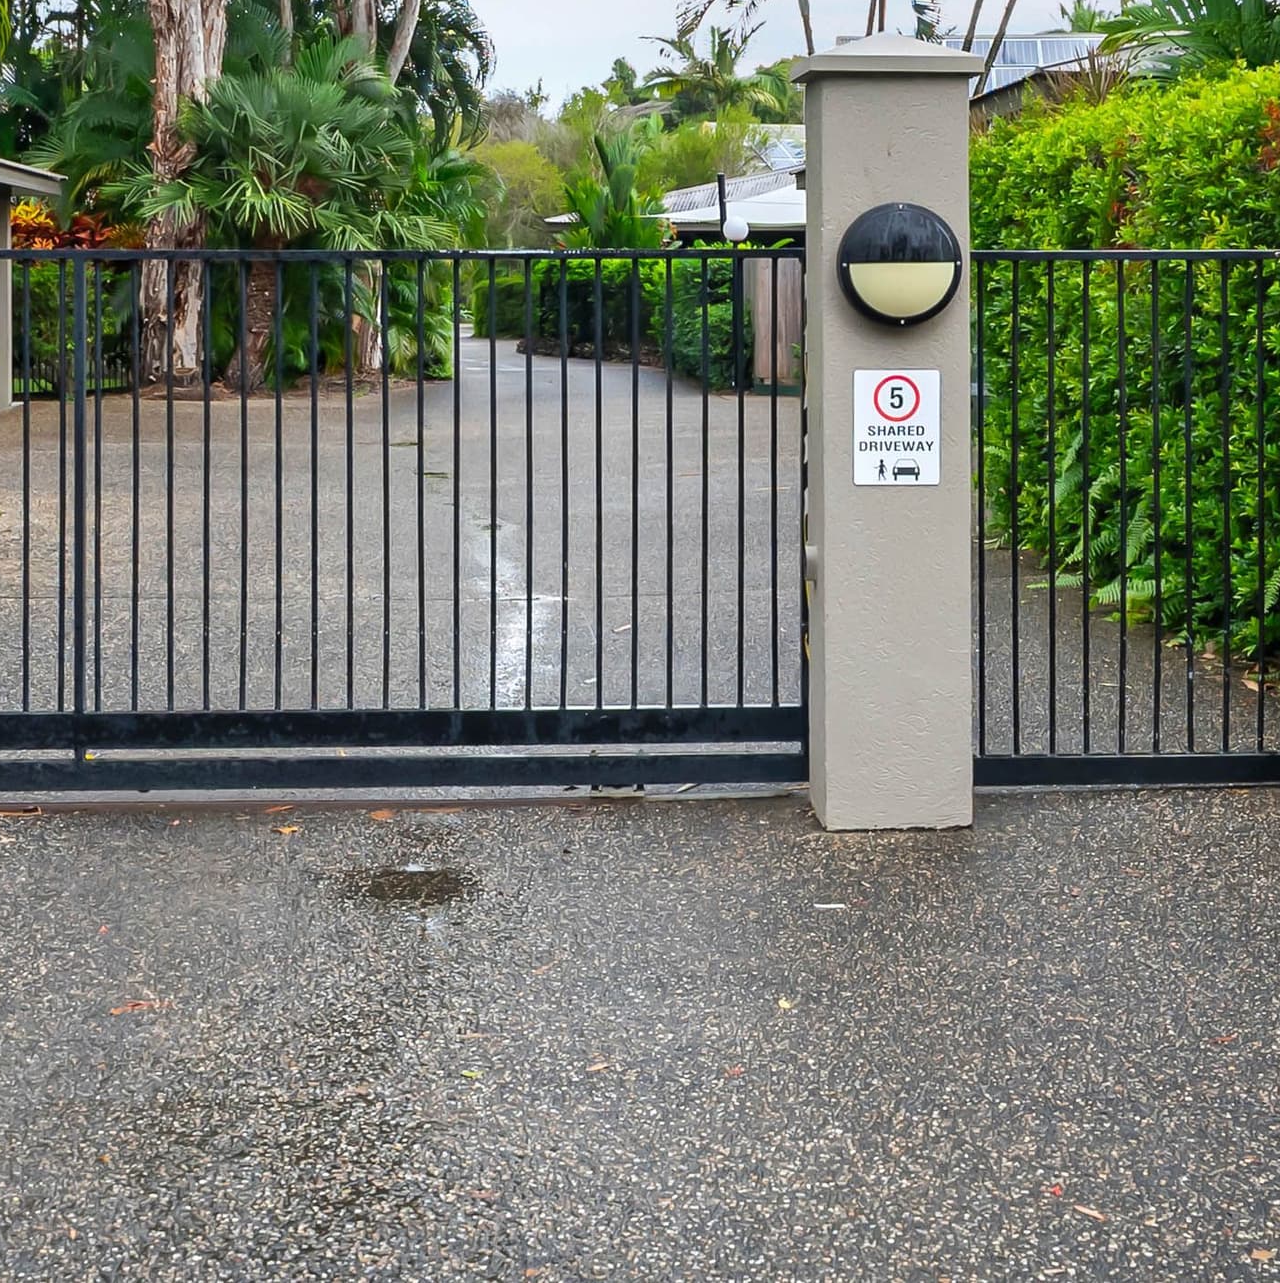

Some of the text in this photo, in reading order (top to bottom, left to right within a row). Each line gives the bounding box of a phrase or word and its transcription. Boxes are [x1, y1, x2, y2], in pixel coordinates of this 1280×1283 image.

[889, 386, 904, 409] 5
[867, 424, 926, 437] SHARED
[858, 440, 935, 452] DRIVEWAY
